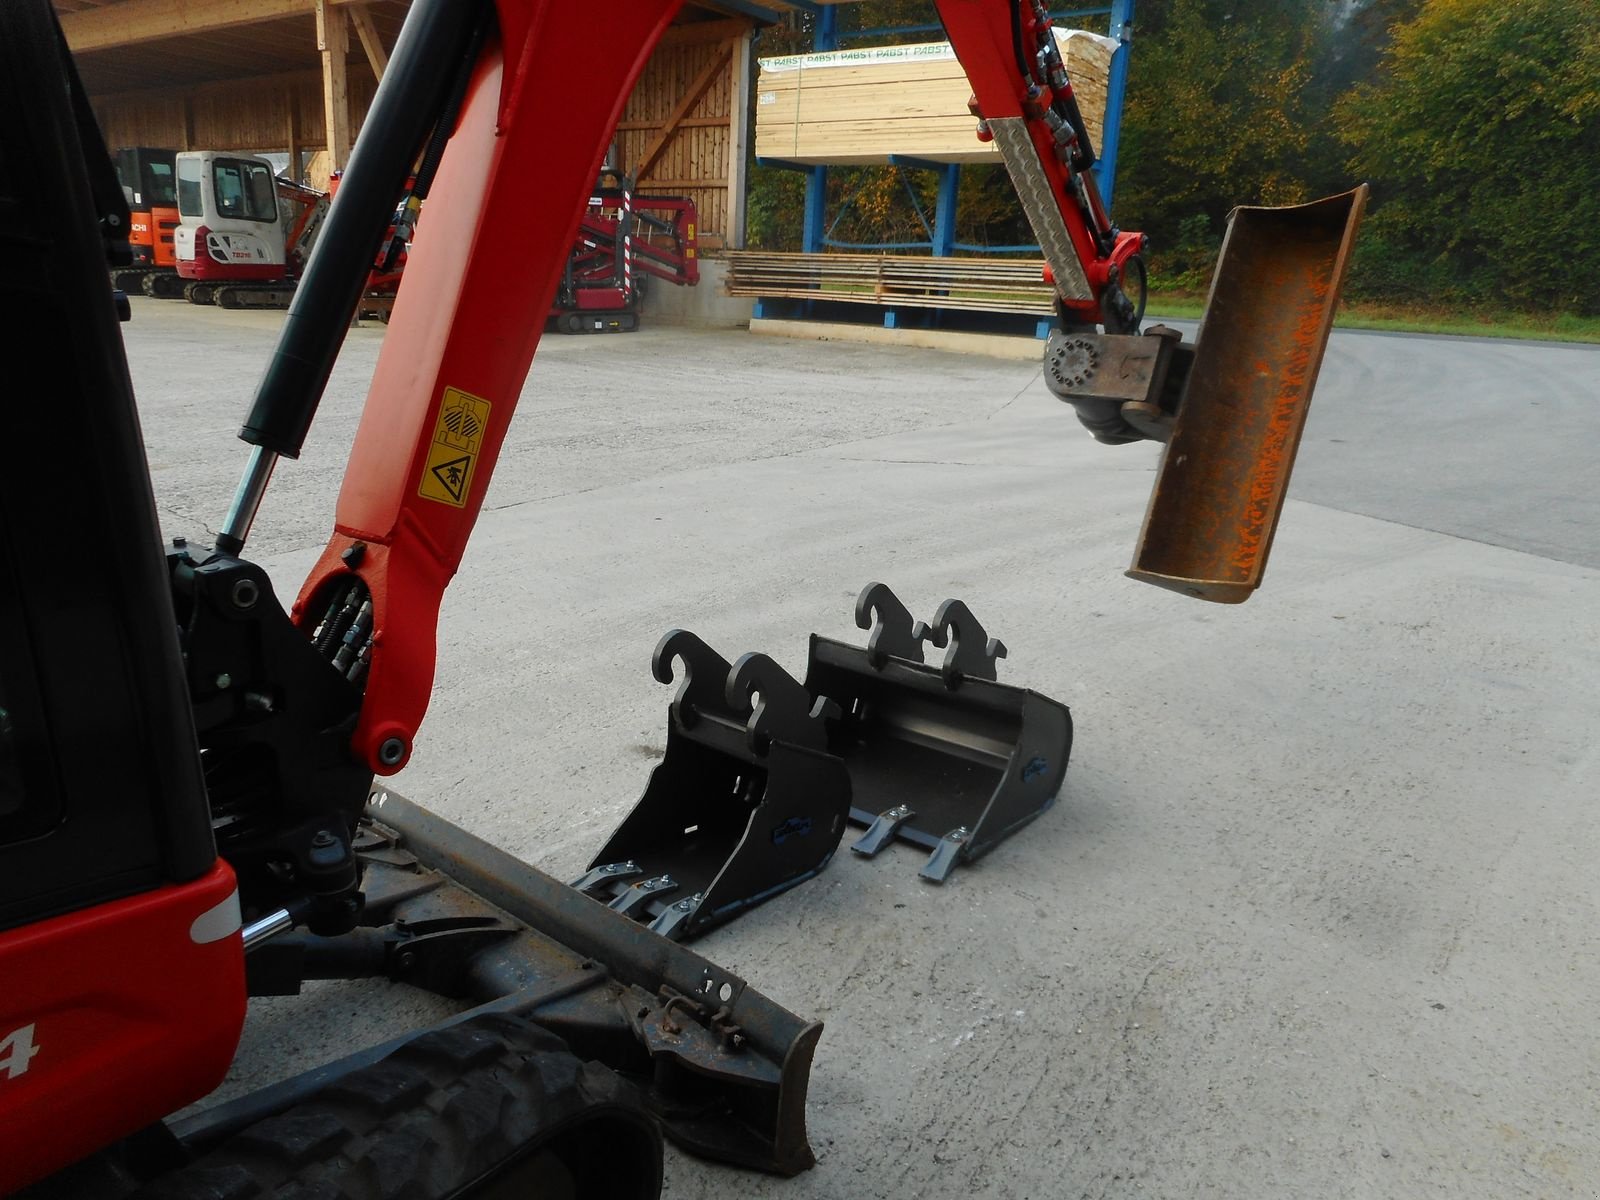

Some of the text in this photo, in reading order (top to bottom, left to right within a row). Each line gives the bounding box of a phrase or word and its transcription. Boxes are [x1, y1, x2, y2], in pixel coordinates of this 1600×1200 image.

[774, 57, 804, 67] PABST
[807, 54, 838, 63] PABST
[841, 50, 873, 60] PABST
[876, 47, 911, 58] PABST
[913, 44, 950, 56] PABST
[0, 1022, 40, 1079] 4
